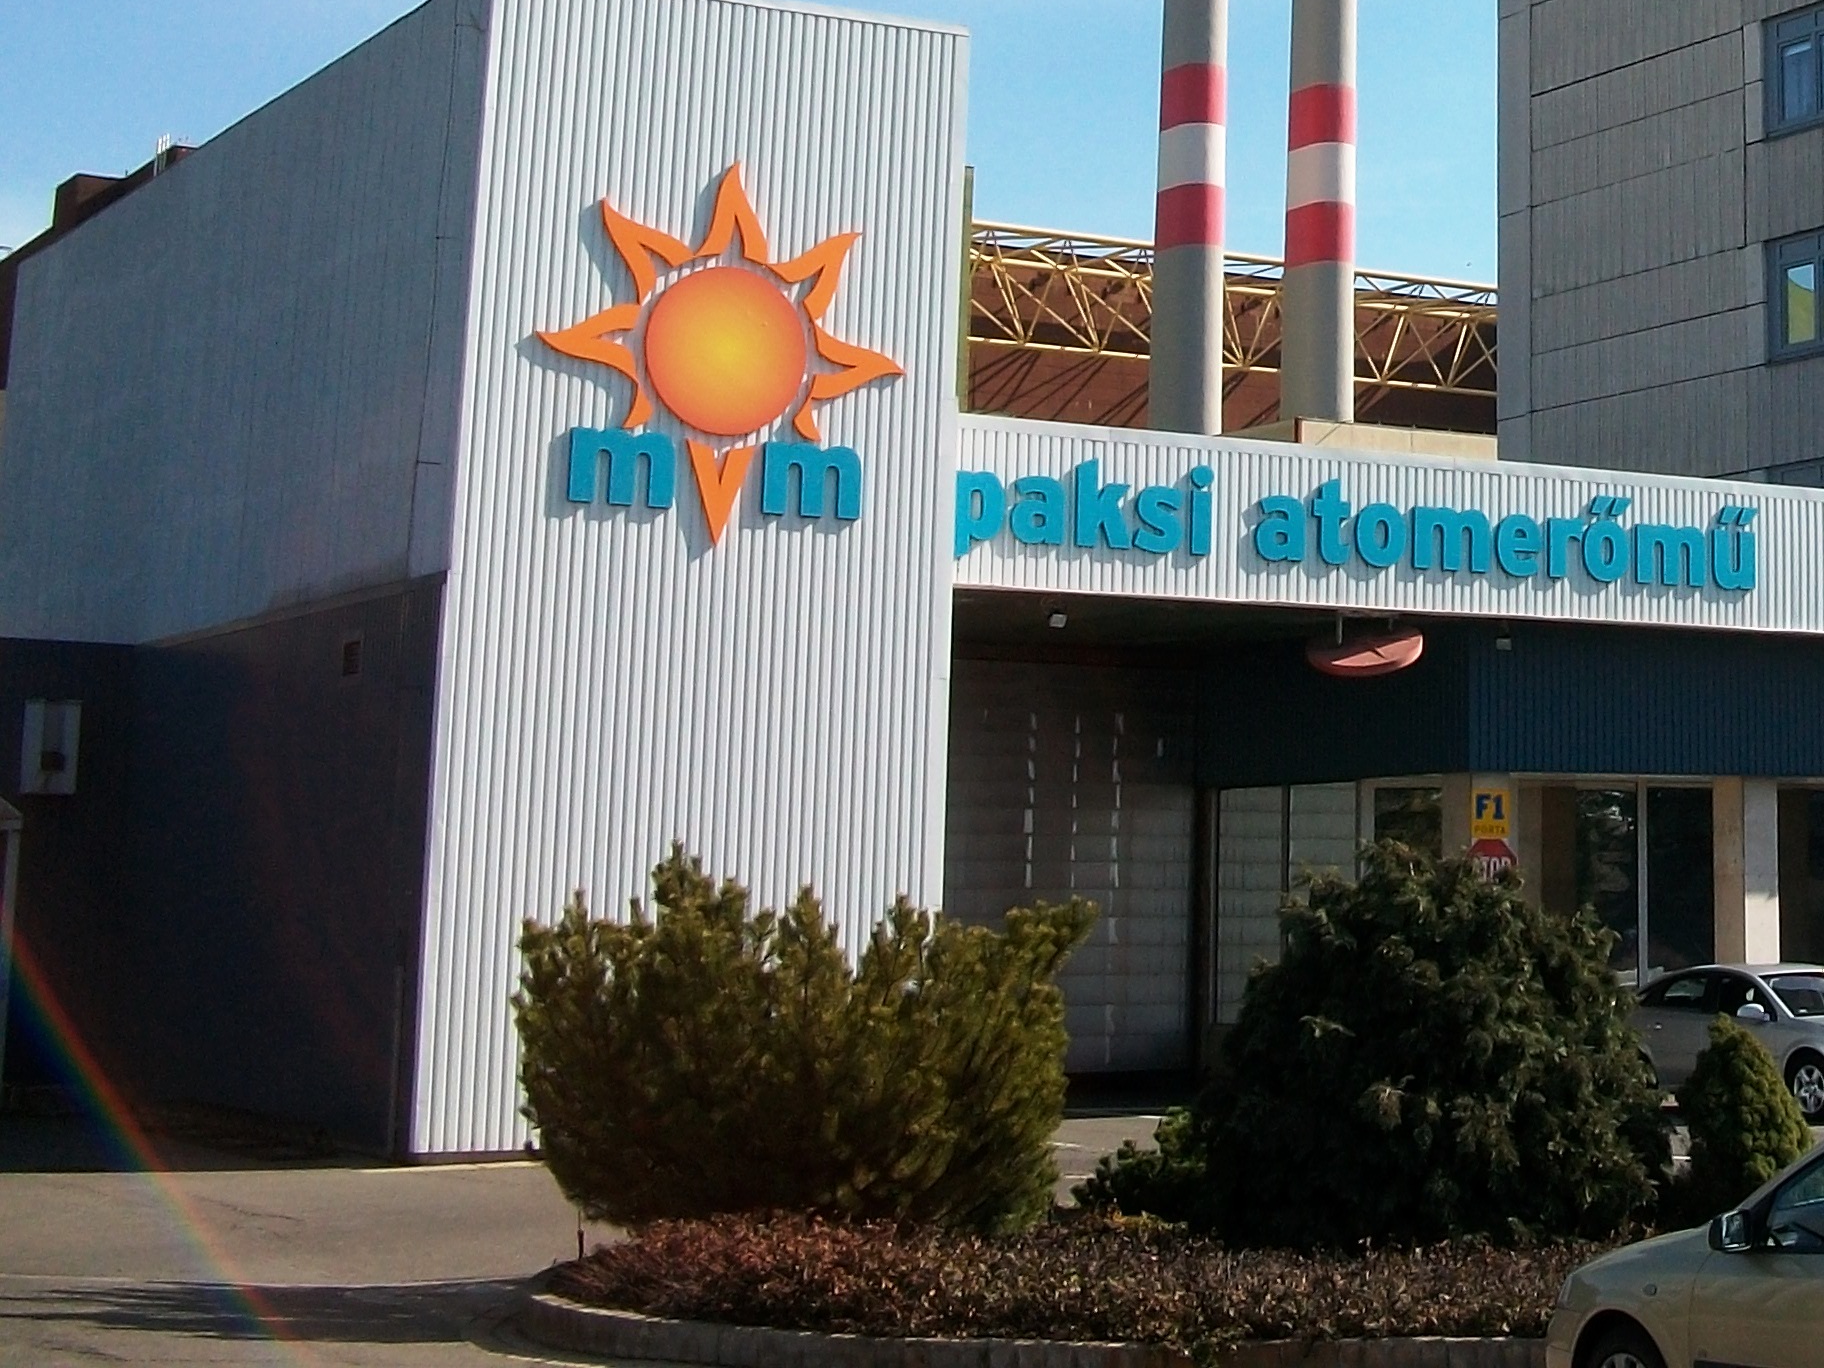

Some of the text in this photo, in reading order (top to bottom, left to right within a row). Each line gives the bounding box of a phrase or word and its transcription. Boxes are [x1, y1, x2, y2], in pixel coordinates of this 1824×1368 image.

[567, 426, 863, 547] mvm
[955, 458, 1759, 591] paksi atomerőmű
[1474, 824, 1506, 834] PORTA
[1476, 794, 1504, 820] F1
